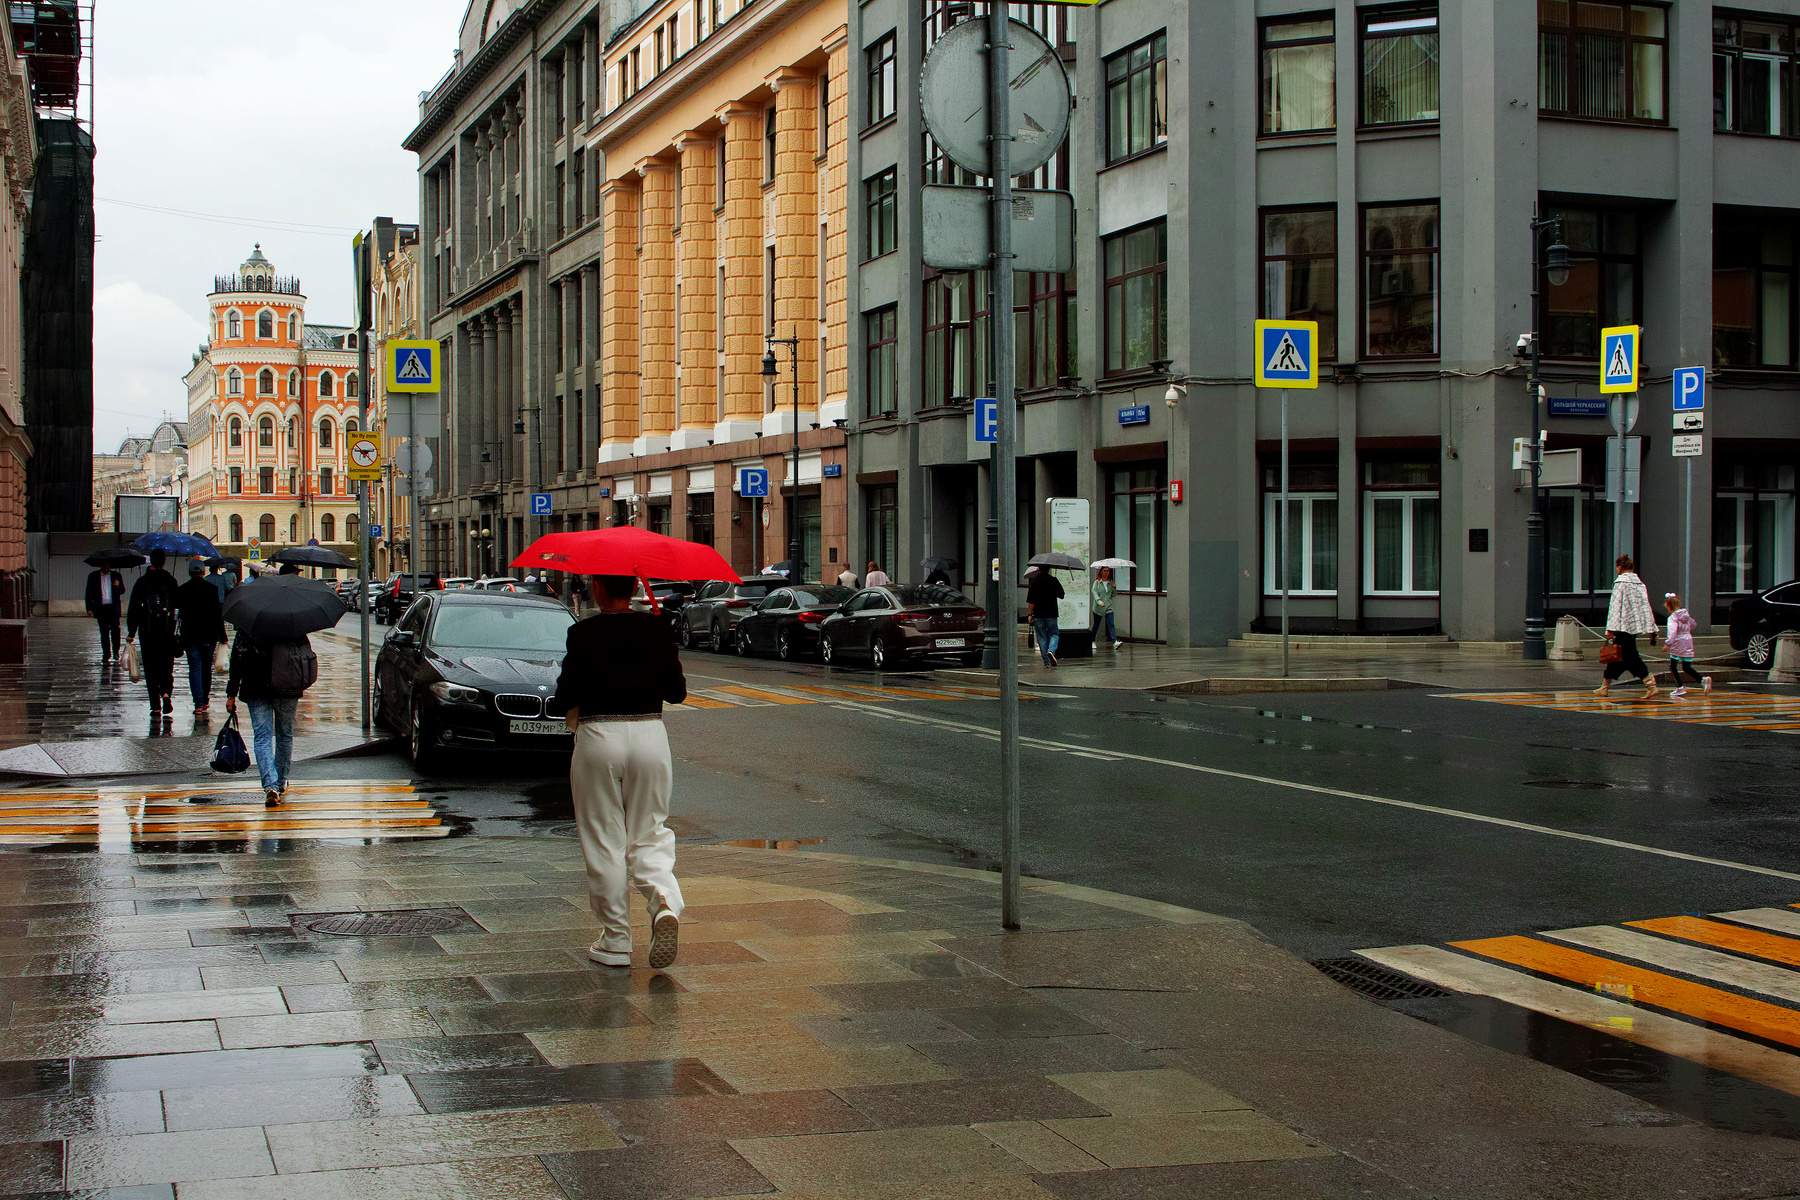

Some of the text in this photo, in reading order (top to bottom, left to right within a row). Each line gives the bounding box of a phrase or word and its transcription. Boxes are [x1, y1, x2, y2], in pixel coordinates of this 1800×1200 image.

[1682, 372, 1699, 405] P
[747, 472, 763, 494] P
[535, 496, 547, 513] P
[372, 526, 380, 536] P
